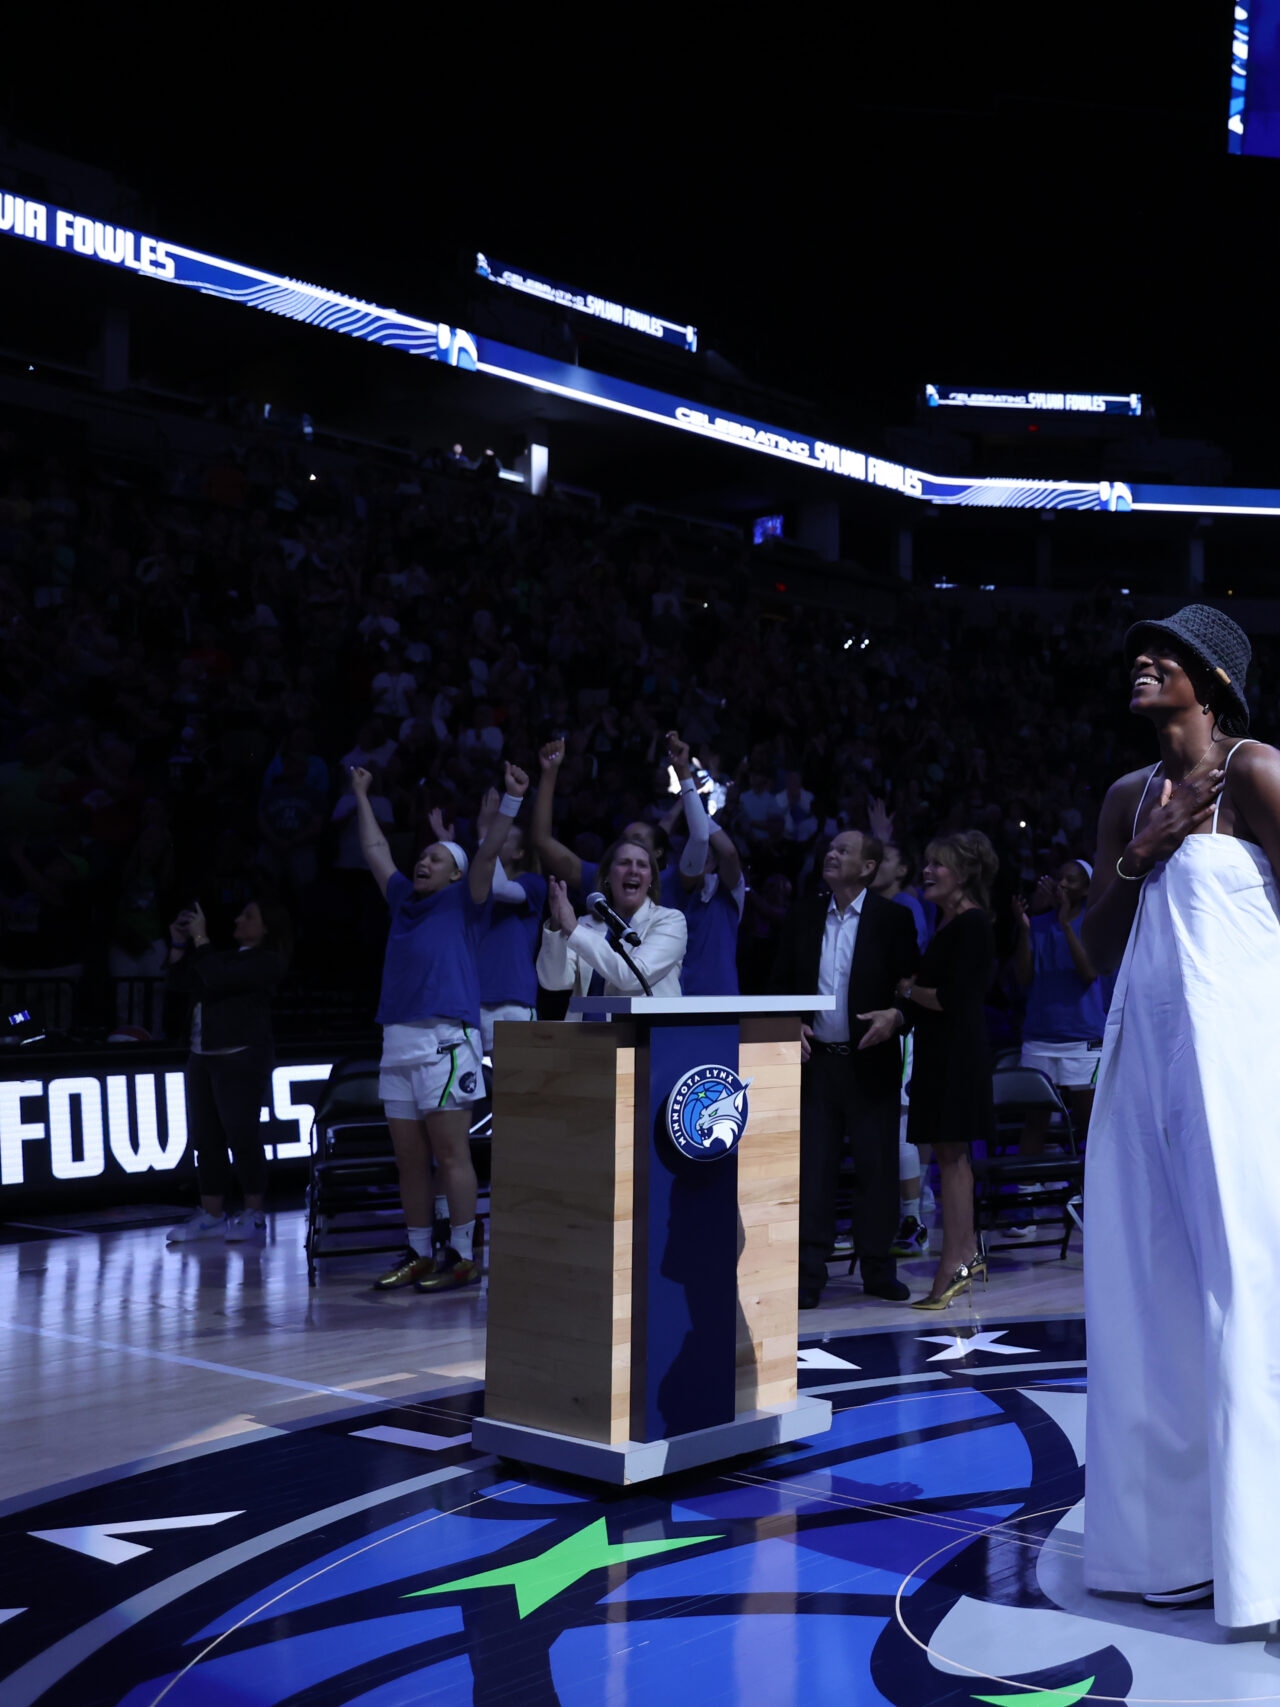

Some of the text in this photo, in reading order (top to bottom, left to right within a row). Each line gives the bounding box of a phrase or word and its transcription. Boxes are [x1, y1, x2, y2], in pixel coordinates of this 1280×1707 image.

[56, 209, 176, 279] FOWLES
[623, 307, 664, 337] FOWLES
[1065, 394, 1106, 412] FOWLES
[675, 406, 923, 497] CELEBRATING SYLVIA FOWLES
[0, 1063, 334, 1185] FOWS
[672, 1069, 734, 1147] MINNESOTA LYNX
